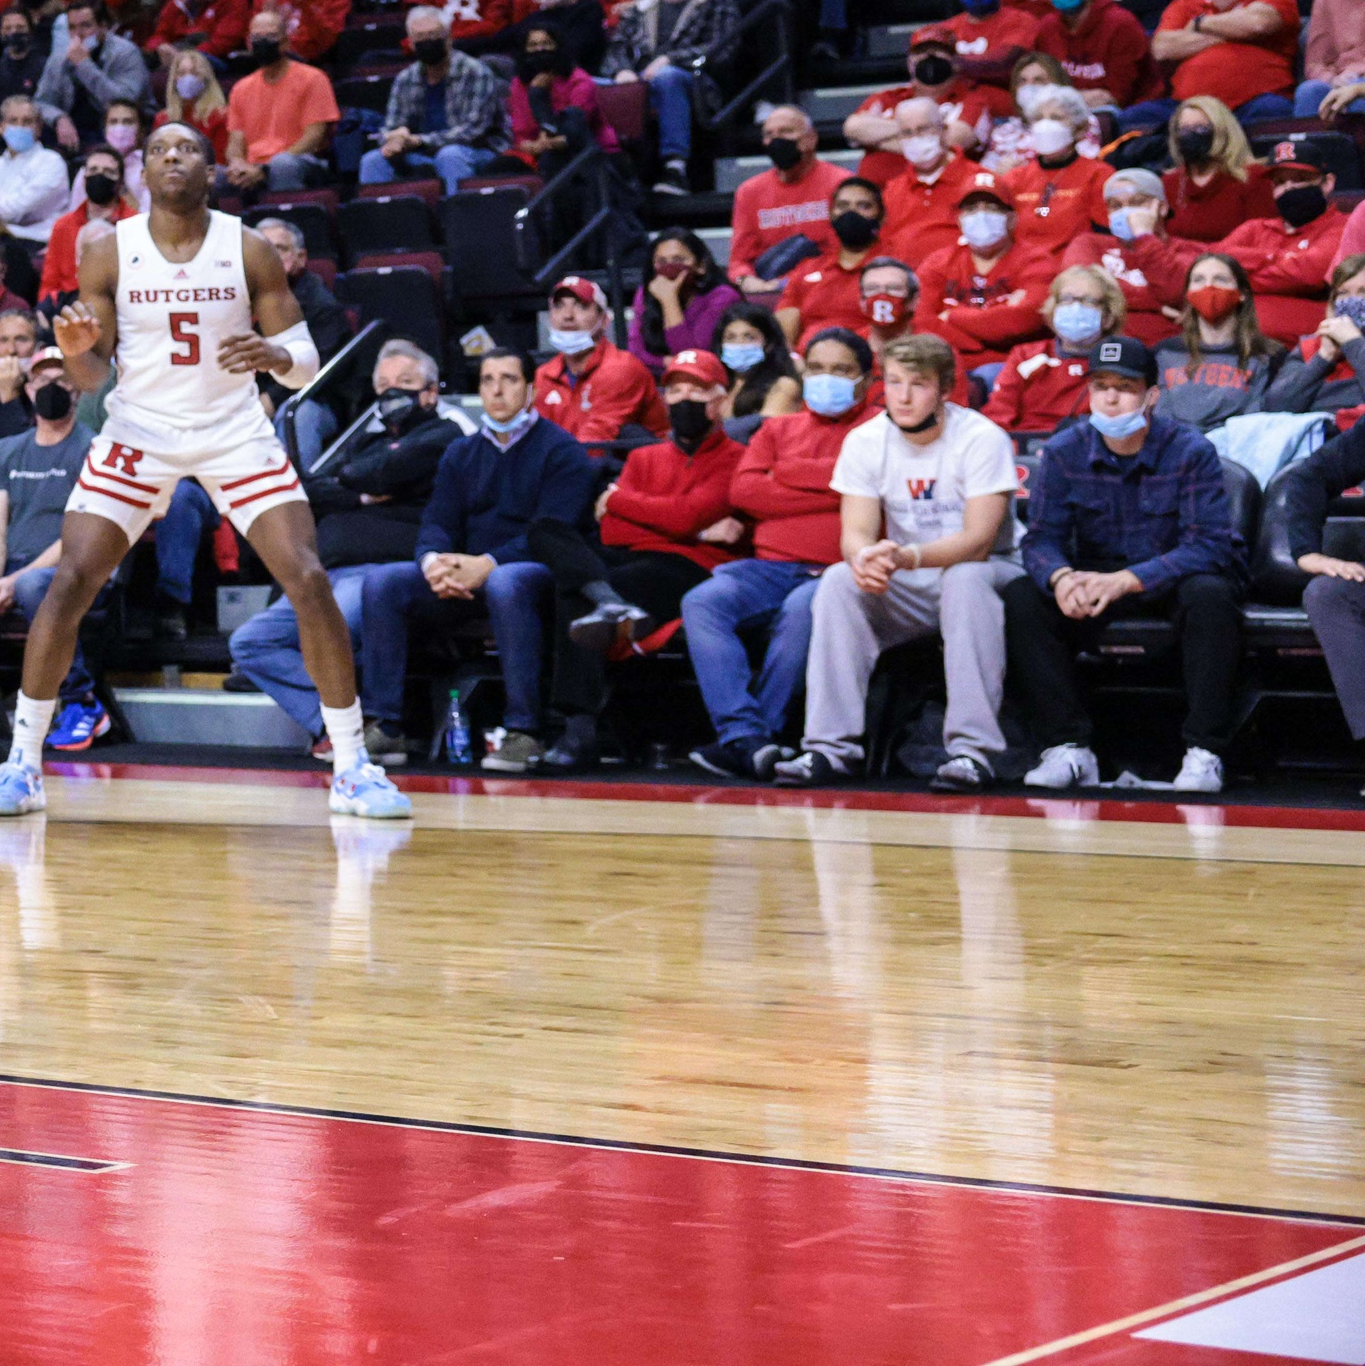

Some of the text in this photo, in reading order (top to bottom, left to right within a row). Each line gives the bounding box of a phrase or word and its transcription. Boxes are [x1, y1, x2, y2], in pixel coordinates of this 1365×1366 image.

[129, 286, 236, 305] RUTGERS
[873, 300, 896, 324] R
[169, 312, 201, 366] 5
[102, 441, 145, 478] R
